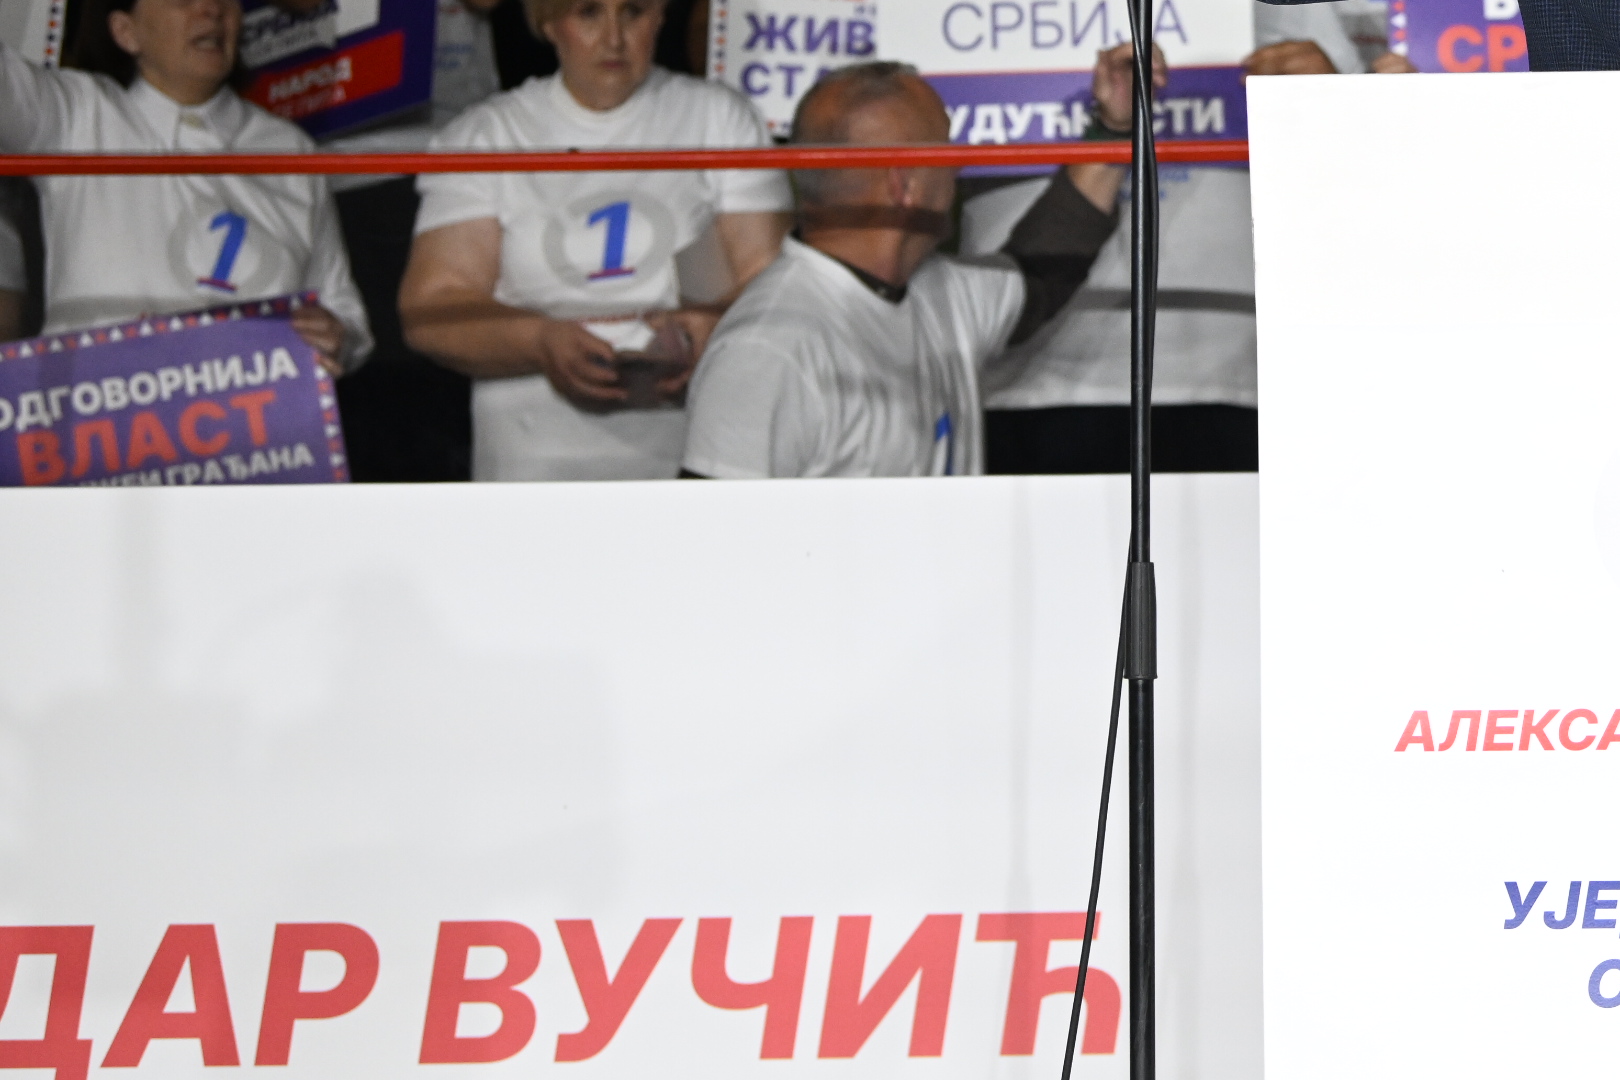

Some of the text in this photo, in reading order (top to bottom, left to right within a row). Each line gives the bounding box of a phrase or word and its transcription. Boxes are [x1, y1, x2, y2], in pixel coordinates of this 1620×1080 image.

[743, 14, 877, 57] ЖИВ
[946, 96, 1227, 146] УДУЋНСТИ
[197, 211, 247, 292] 1
[586, 202, 634, 281] 1
[16, 388, 277, 486] ВЛАСТ
[417, 911, 1124, 1065] ВУЧИЋ
